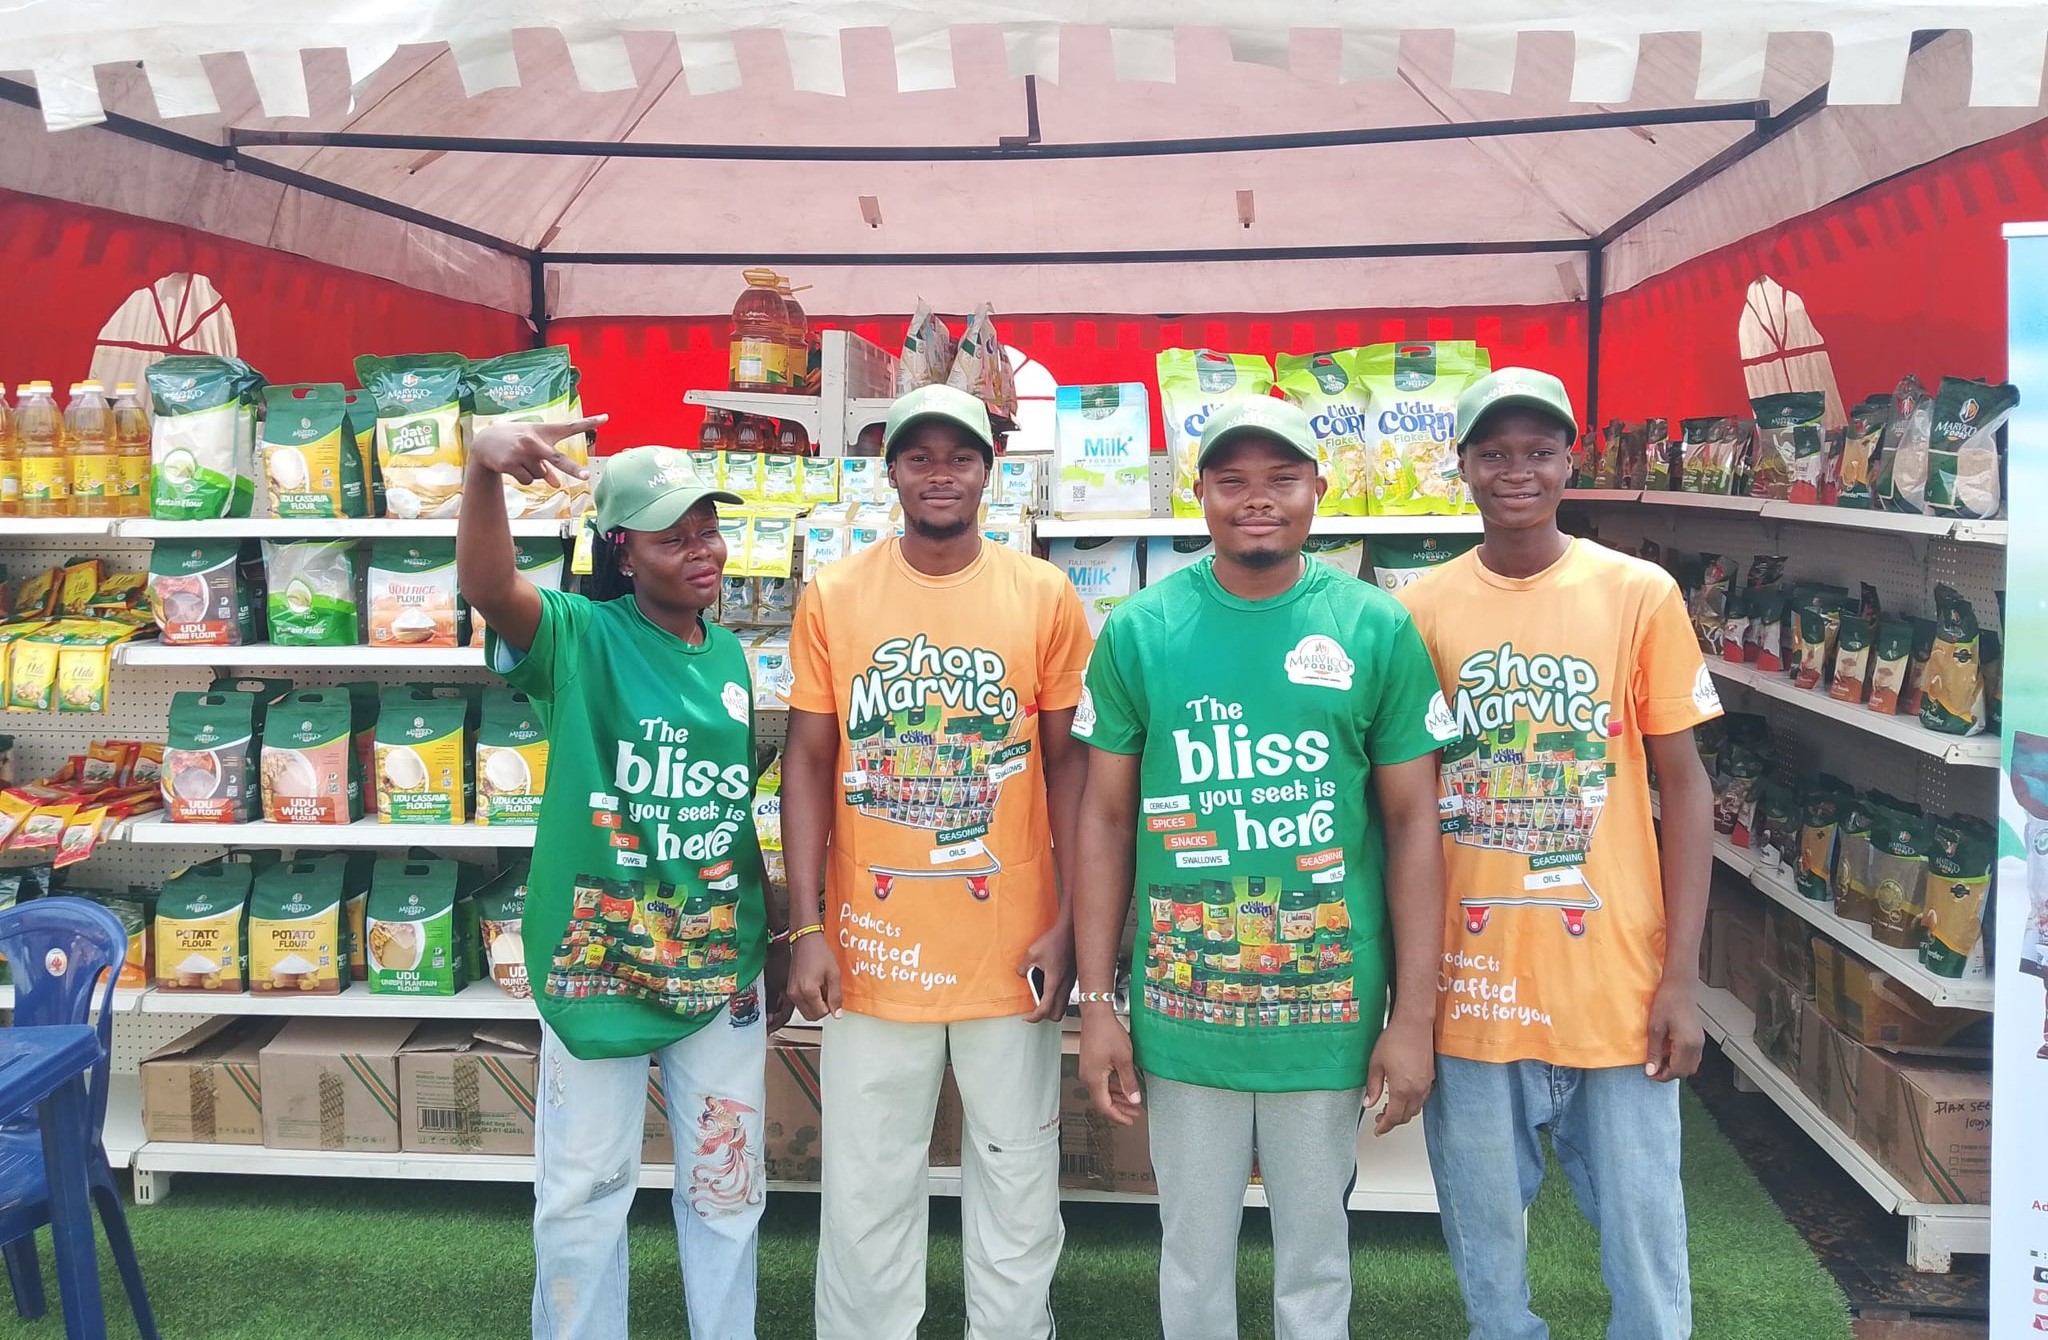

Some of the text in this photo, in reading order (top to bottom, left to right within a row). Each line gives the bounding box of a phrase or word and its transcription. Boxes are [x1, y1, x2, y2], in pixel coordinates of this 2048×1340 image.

[388, 388, 432, 400] MARVICO
[489, 384, 534, 397] MARVICO
[1327, 404, 1356, 418] Udu
[1396, 402, 1434, 415] Udu
[401, 426, 426, 437] Oat
[1935, 421, 1977, 437] MARVICO
[1325, 435, 1359, 448] Flakes
[1394, 434, 1431, 443] Flakes
[1084, 437, 1130, 457] Milk
[1068, 566, 1111, 586] Milk
[180, 624, 206, 633] UDU
[873, 633, 1005, 683] Shop
[1290, 654, 1351, 672] MARVICO
[1304, 663, 1340, 673] FOODS
[1459, 641, 1597, 696] Shop
[849, 667, 1017, 731] Marvico
[1185, 695, 1243, 723] The
[639, 716, 689, 744] The
[1172, 724, 1331, 784] bliss
[614, 739, 749, 800] bliss
[393, 794, 448, 802] UDU CASSAVA
[493, 797, 511, 805] UDU
[1199, 778, 1336, 815] you seek is
[189, 800, 214, 808] UDU
[290, 799, 317, 807] UDU
[406, 802, 433, 810] FLOUR
[505, 804, 533, 812] FLOUR
[1149, 801, 1179, 809] CEREALS
[200, 808, 223, 816] FLOUR
[281, 807, 327, 816] WHEAT
[629, 801, 670, 824] you
[677, 800, 720, 822] seek
[725, 803, 747, 822] is
[1152, 817, 1186, 828] SPICES
[1233, 799, 1335, 851] here
[939, 825, 986, 842] SEASONING
[656, 821, 739, 861] here
[1170, 836, 1208, 847] SNACKS
[949, 848, 967, 858] OILS
[1300, 850, 1343, 868] SEASONING
[1182, 856, 1222, 864] SWALLOWS
[1532, 853, 1584, 867] SEASONING
[1543, 874, 1561, 884] OILS
[176, 929, 220, 940] POTATO
[272, 929, 316, 940] POTATO
[182, 940, 212, 948] FLOUR
[279, 940, 308, 948] FLOUR
[840, 928, 922, 968] Crafted
[396, 972, 420, 981] UDU
[509, 966, 527, 978] UD
[852, 957, 958, 991] just for you
[405, 979, 437, 987] PLANTAIN
[1436, 973, 1518, 1003] Crafted
[1451, 1000, 1552, 1026] just for you
